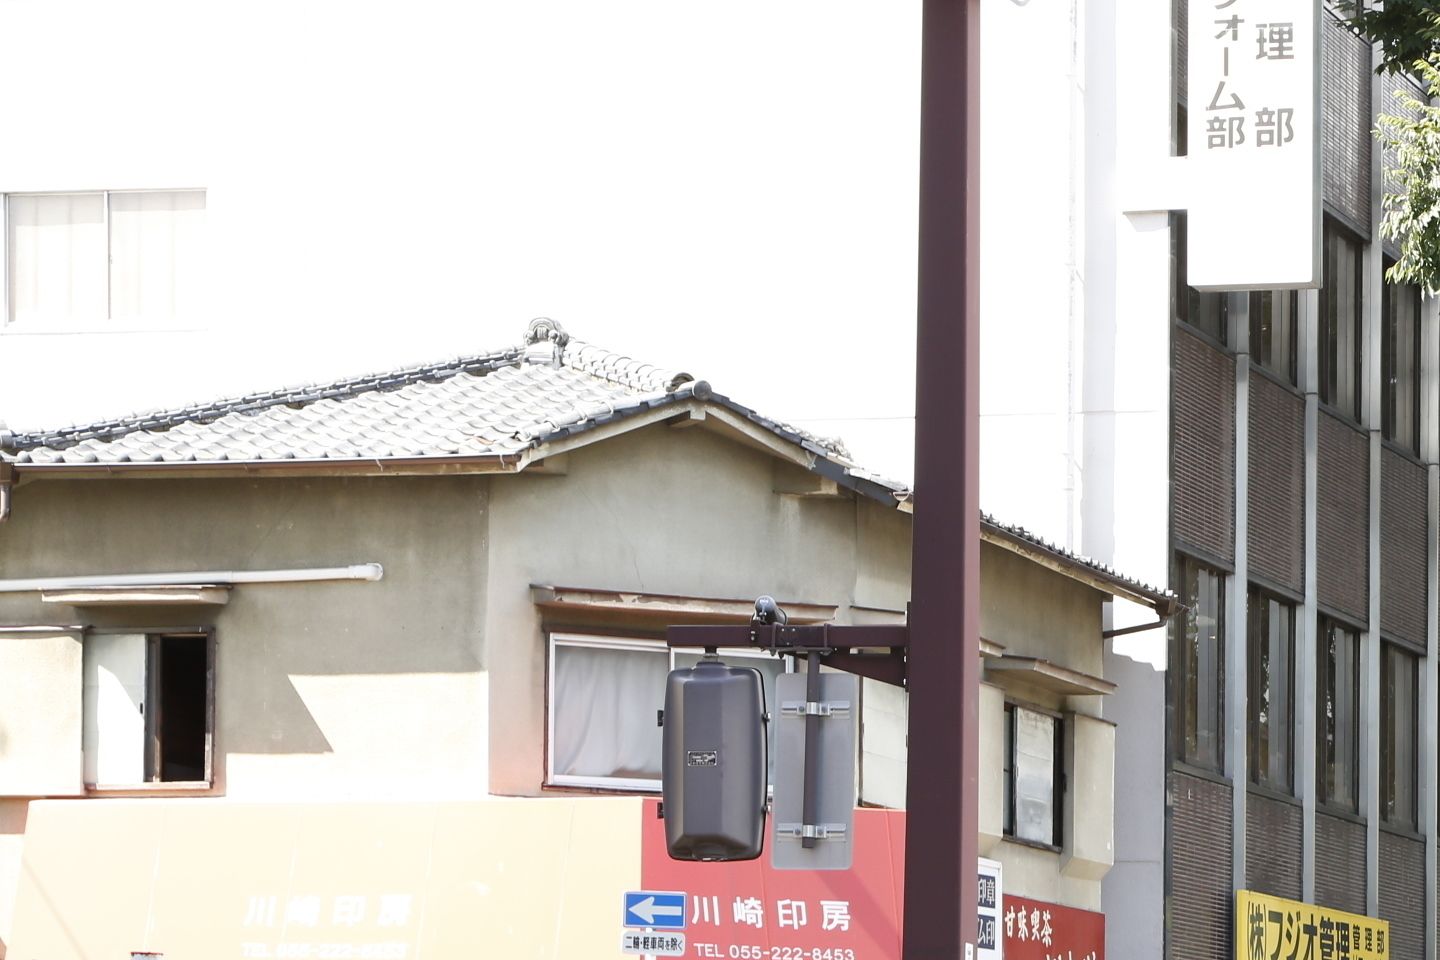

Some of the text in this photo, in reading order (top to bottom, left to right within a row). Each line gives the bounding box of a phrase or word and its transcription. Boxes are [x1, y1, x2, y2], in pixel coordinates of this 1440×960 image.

[692, 895, 851, 932] 川崎印房
[1004, 905, 1053, 948] 甘味喫茶
[693, 942, 725, 959] TEL
[1353, 923, 1385, 955] 管理部
